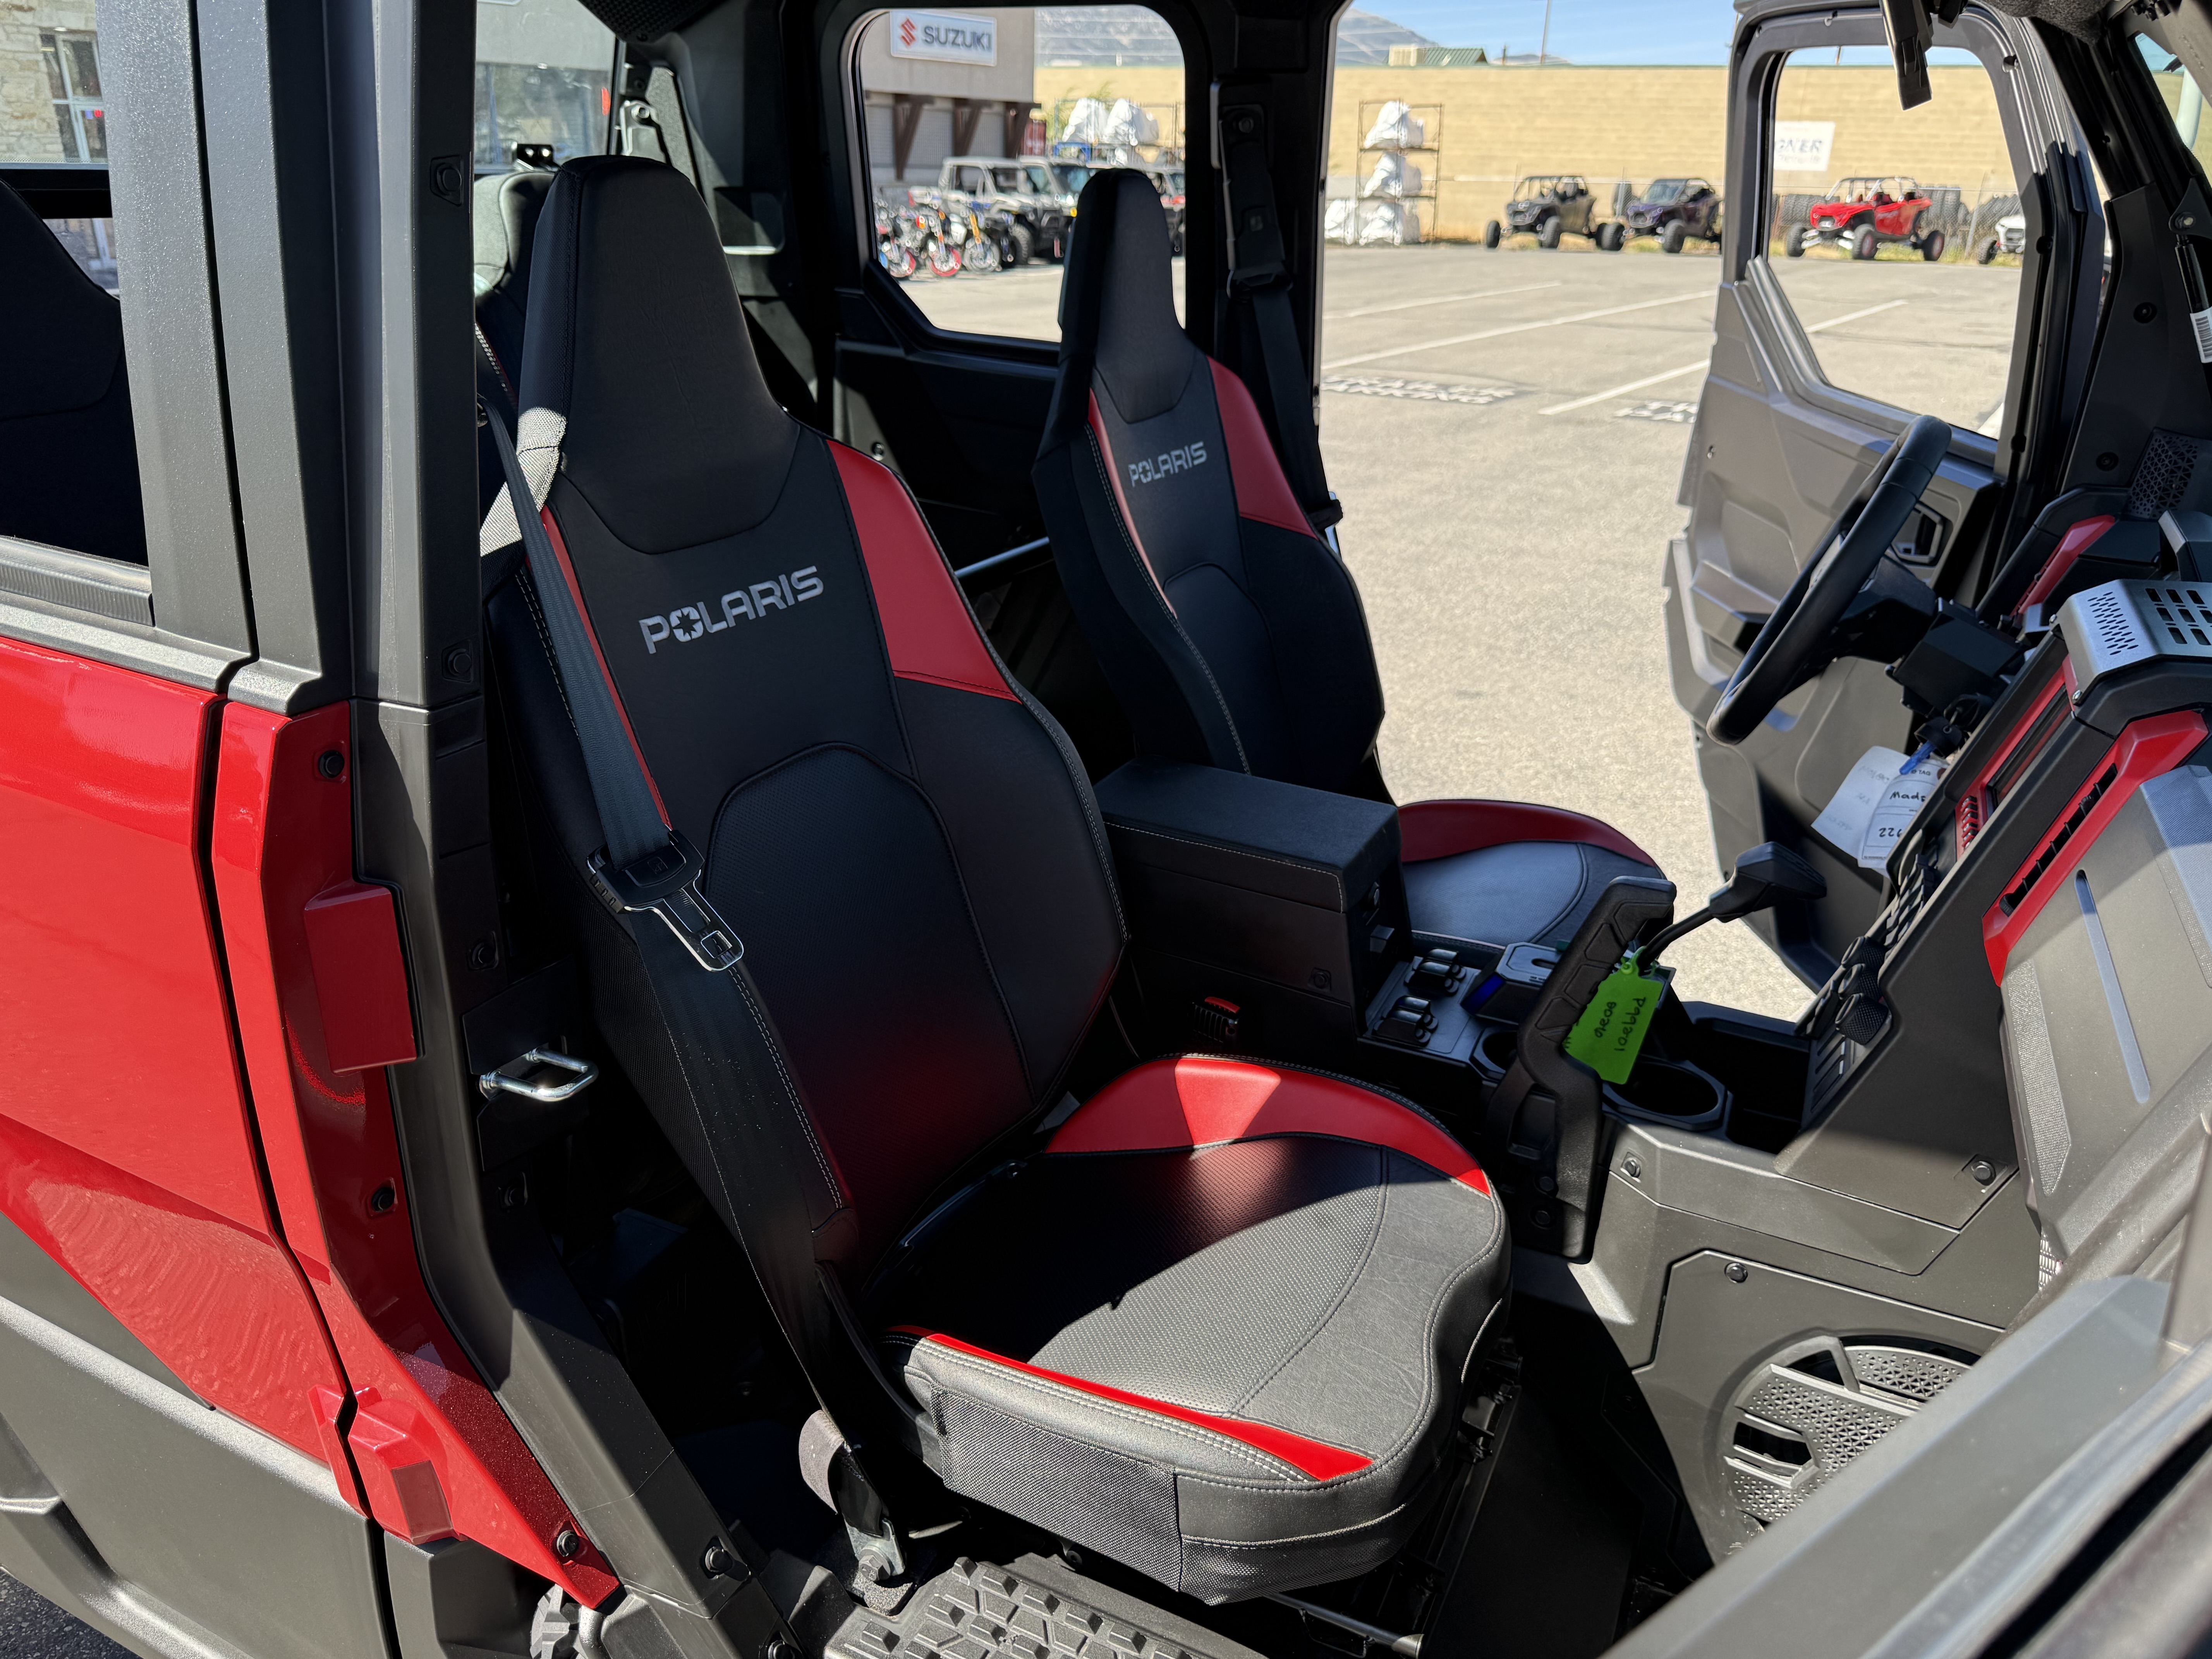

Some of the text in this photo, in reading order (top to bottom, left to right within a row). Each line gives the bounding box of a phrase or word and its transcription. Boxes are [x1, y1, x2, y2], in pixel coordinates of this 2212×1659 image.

[923, 26, 992, 52] SUZUKI
[1127, 440, 1208, 488] POLARIS
[639, 565, 824, 654] POLARIS
